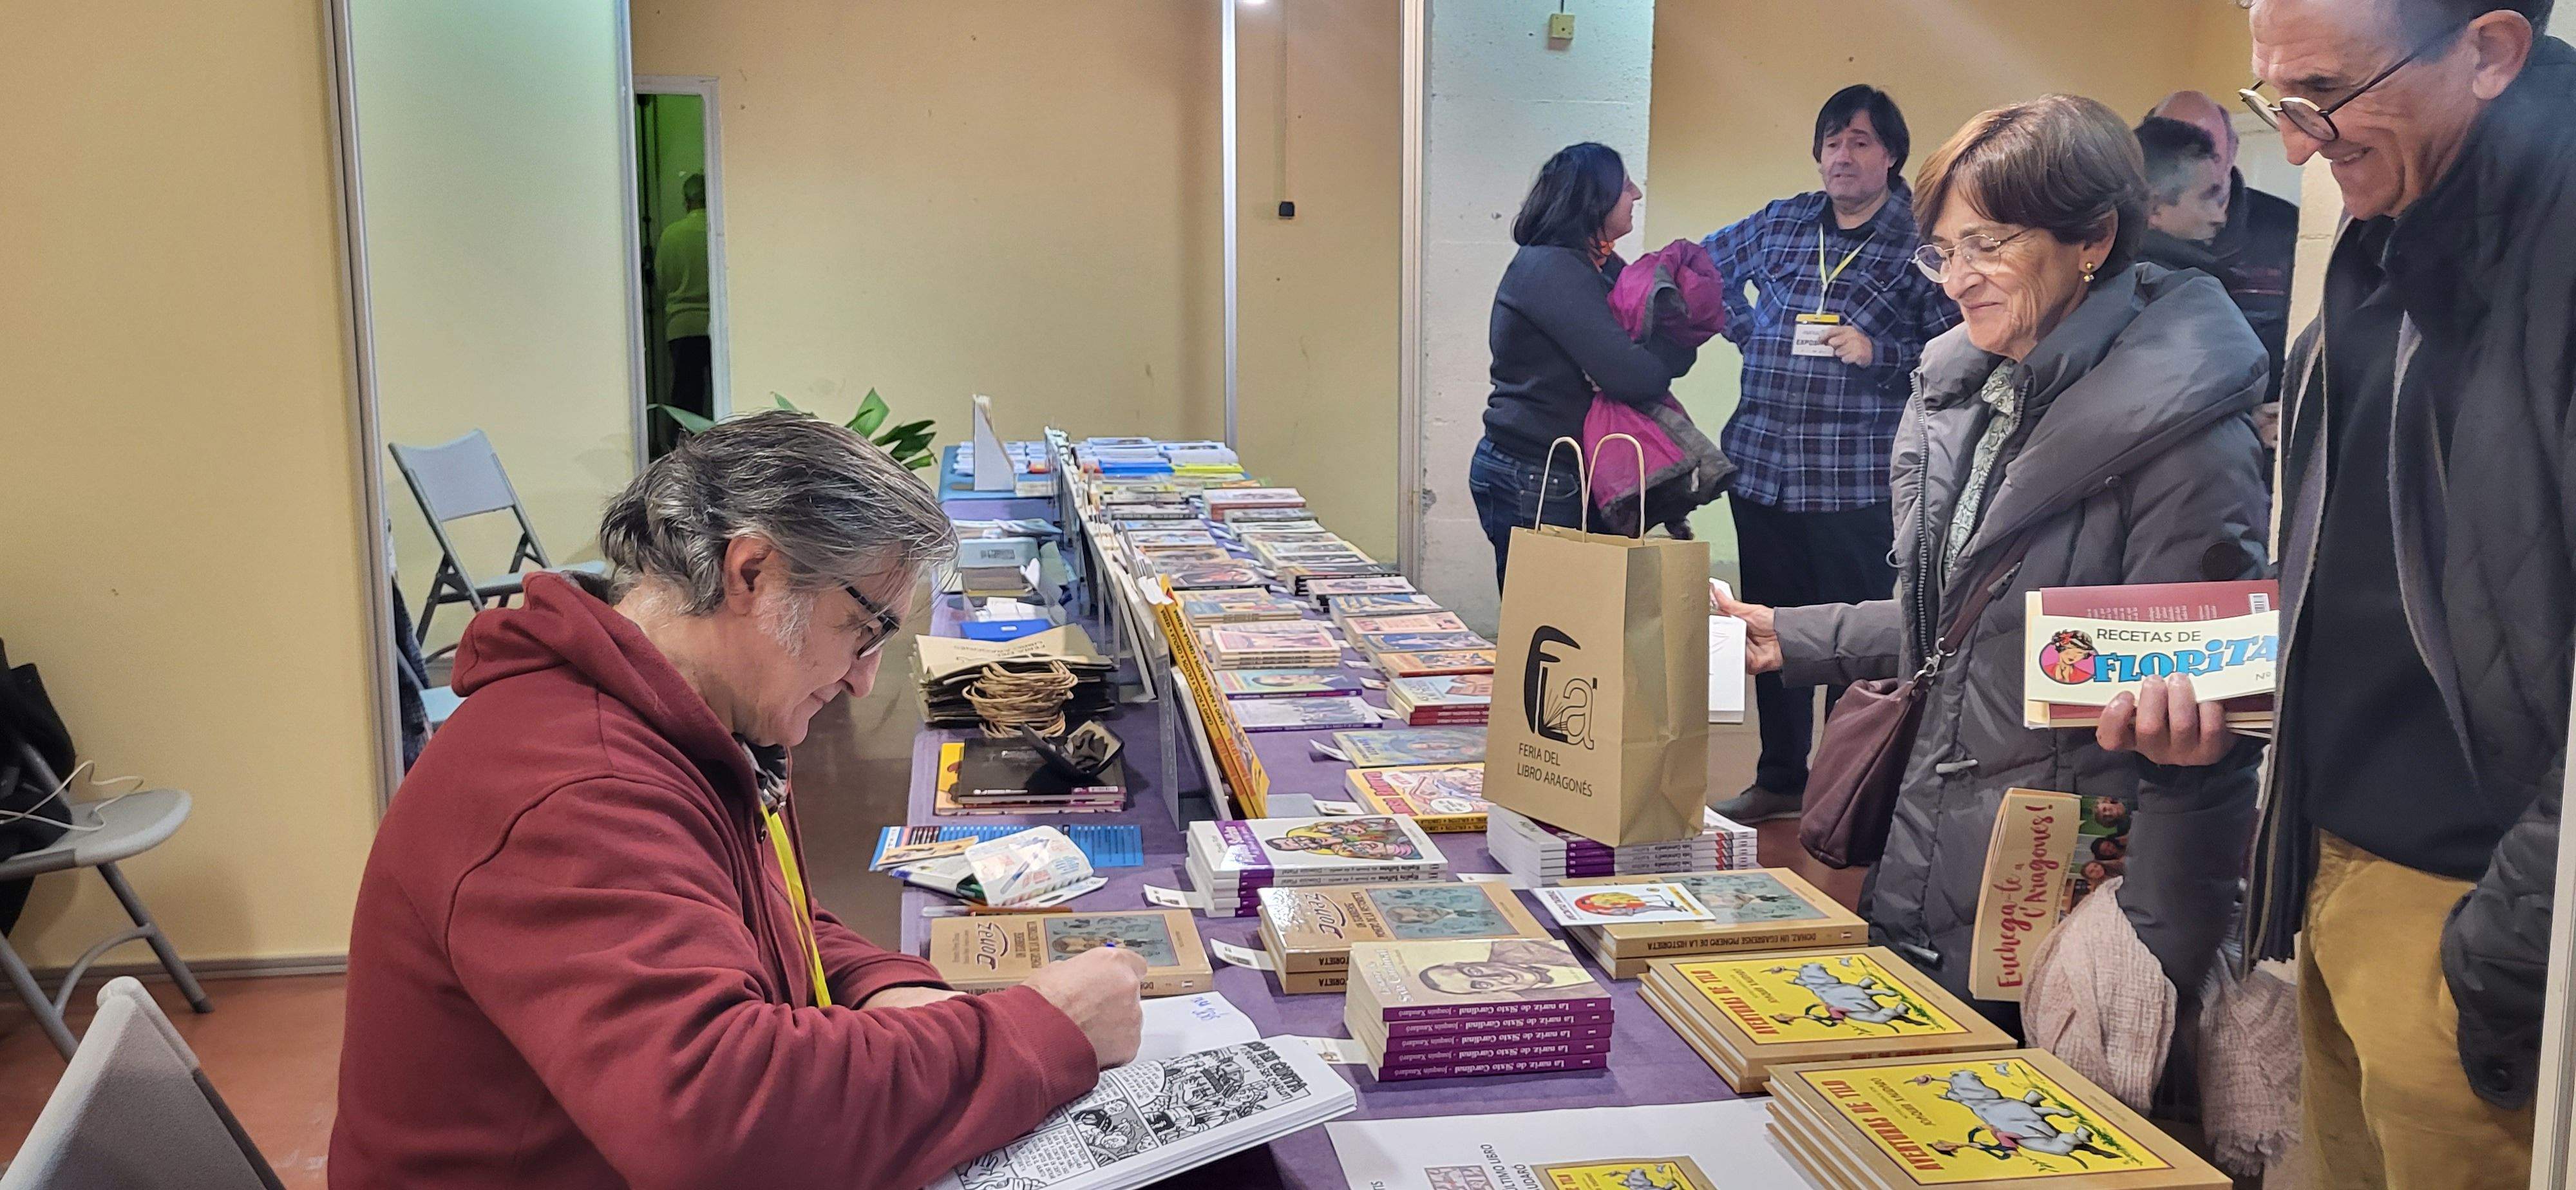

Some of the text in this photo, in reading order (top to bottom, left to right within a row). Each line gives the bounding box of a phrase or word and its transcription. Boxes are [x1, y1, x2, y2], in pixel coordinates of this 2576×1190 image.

[2097, 628, 2202, 643] RECETAS DE
[1519, 742, 1561, 766] FERIA DEL
[1517, 763, 1593, 797] LIBRO ARAGONÉS
[1647, 940, 1686, 949] HISTORIETA
[1710, 937, 1739, 945] PIONERO
[1459, 1006, 1494, 1015] Cardinal
[1558, 1002, 1569, 1010] La
[1564, 1015, 1574, 1023] La
[1719, 997, 1779, 1034] AVENTURAS
[1465, 1020, 1500, 1029] Cardinal
[1502, 1018, 1524, 1026] Sixto
[1461, 1035, 1497, 1044] Cardinal
[1459, 1049, 1493, 1058] Cardinal
[1497, 1047, 1518, 1055] Sixto
[1492, 1062, 1513, 1071] Sixto
[1555, 1059, 1564, 1068] La
[1455, 1064, 1490, 1073] Cardinal
[1845, 1102, 1879, 1113] DE
[1862, 1117, 1944, 1170] AVENTURAS
[1481, 1144, 1501, 1169] LIBRO
